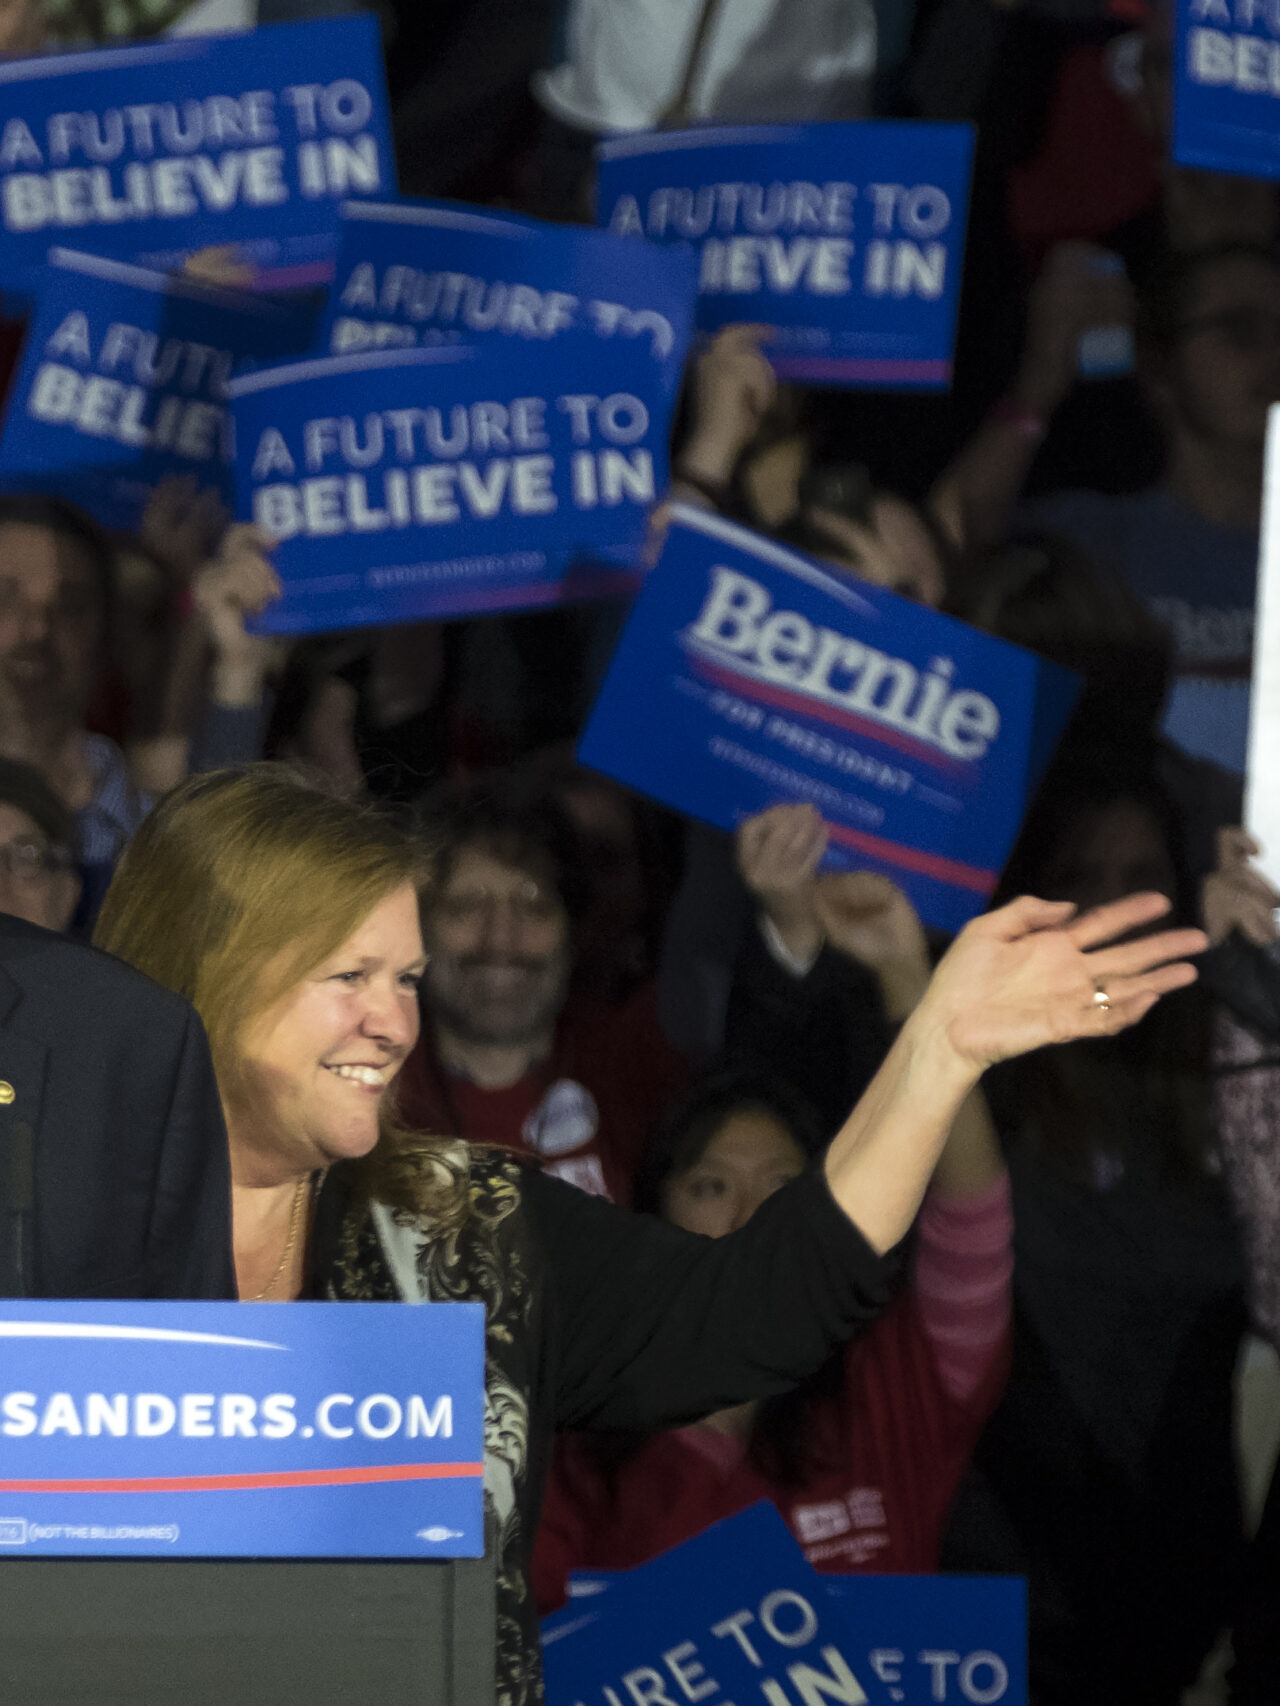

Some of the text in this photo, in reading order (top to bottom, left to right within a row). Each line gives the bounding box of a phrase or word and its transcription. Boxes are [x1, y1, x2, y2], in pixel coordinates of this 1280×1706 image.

[0, 79, 372, 168] A FUTURE TO
[2, 134, 379, 231] BELIEVE IN
[610, 181, 951, 239] A FUTURE TO
[340, 262, 377, 308] A
[865, 240, 947, 298] IN
[46, 310, 91, 366] A
[253, 393, 651, 479] A FUTURE TO
[252, 449, 654, 539] BELIEVE IN
[685, 562, 1002, 763] Bernie
[711, 1589, 818, 1668] TO
[919, 1649, 1009, 1704] TO
